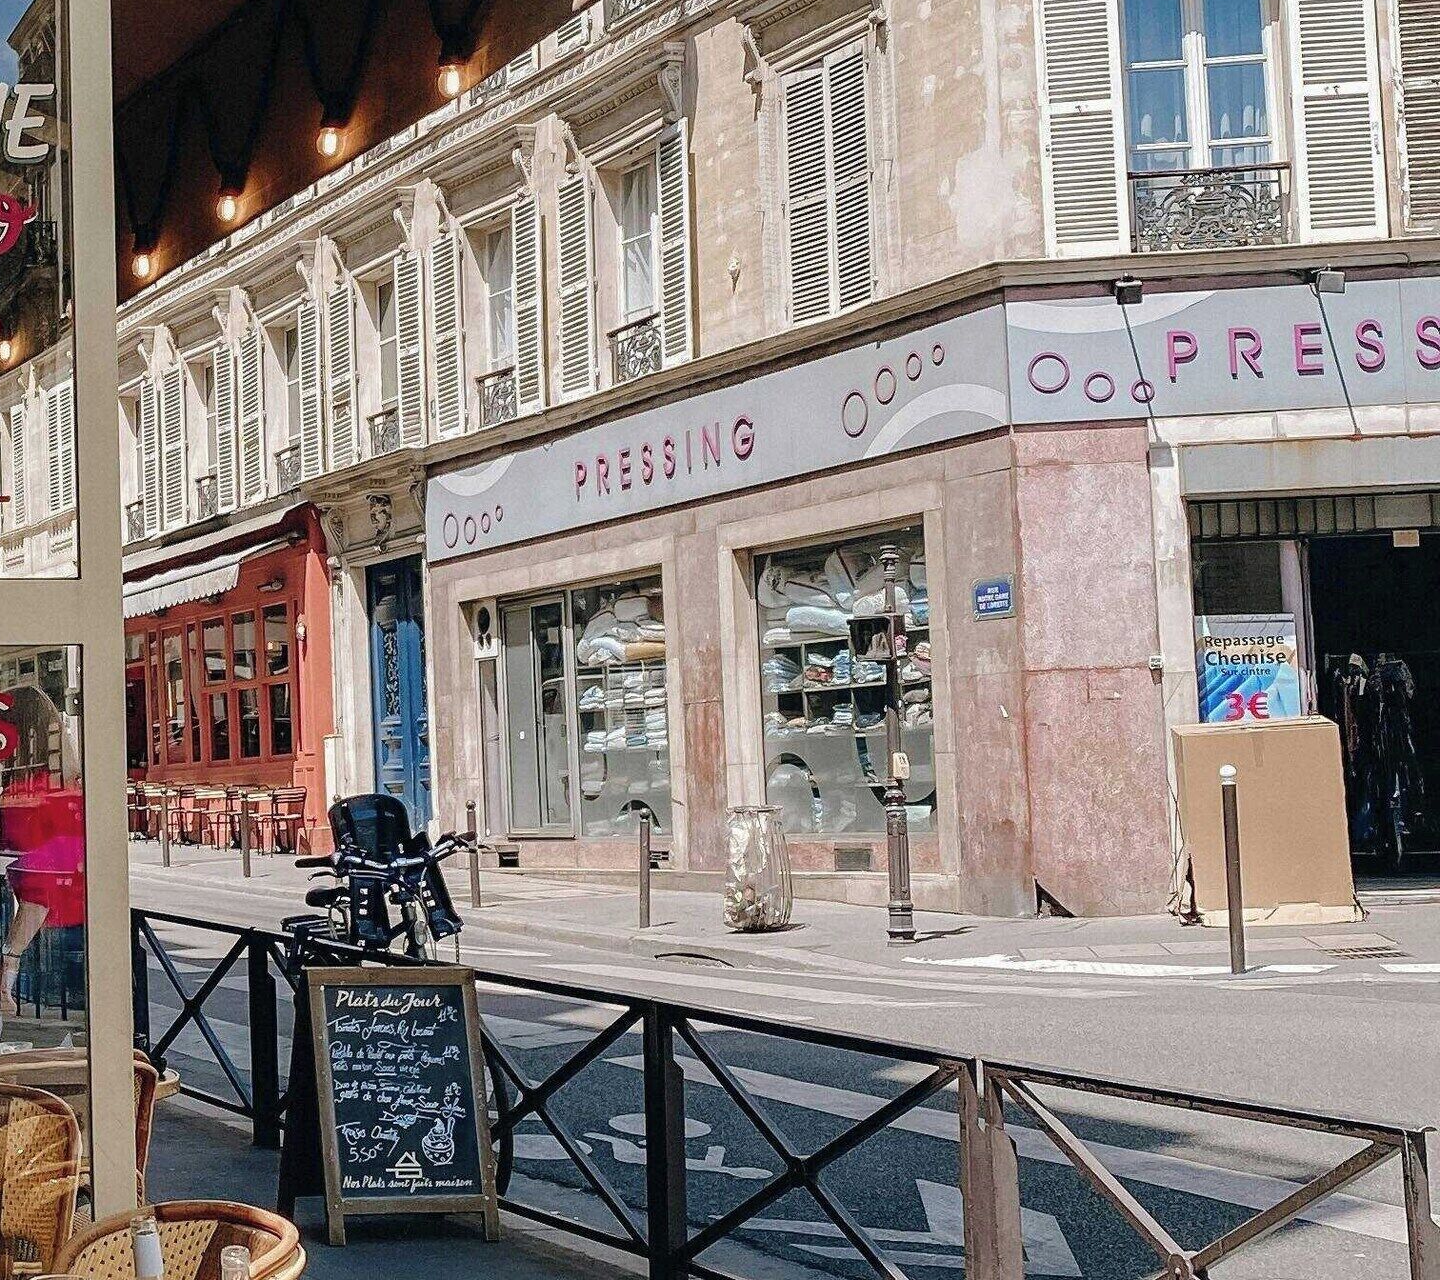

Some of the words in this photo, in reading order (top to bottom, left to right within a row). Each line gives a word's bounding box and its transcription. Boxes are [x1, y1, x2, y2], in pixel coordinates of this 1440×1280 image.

[1166, 315, 1440, 381] PRESS
[573, 415, 756, 502] PRESSING
[1204, 635, 1285, 649] Repassage
[1205, 650, 1287, 666] Chemise
[1241, 668, 1271, 676] cintre
[1226, 692, 1270, 721] 3€
[336, 990, 379, 1007] Plats
[380, 994, 402, 1007] du
[400, 992, 443, 1015] Jour
[342, 1176, 360, 1188] Nos
[362, 1176, 385, 1188] Plats
[388, 1179, 409, 1188] sont
[409, 1177, 433, 1193] faits
[435, 1179, 472, 1188] maison
